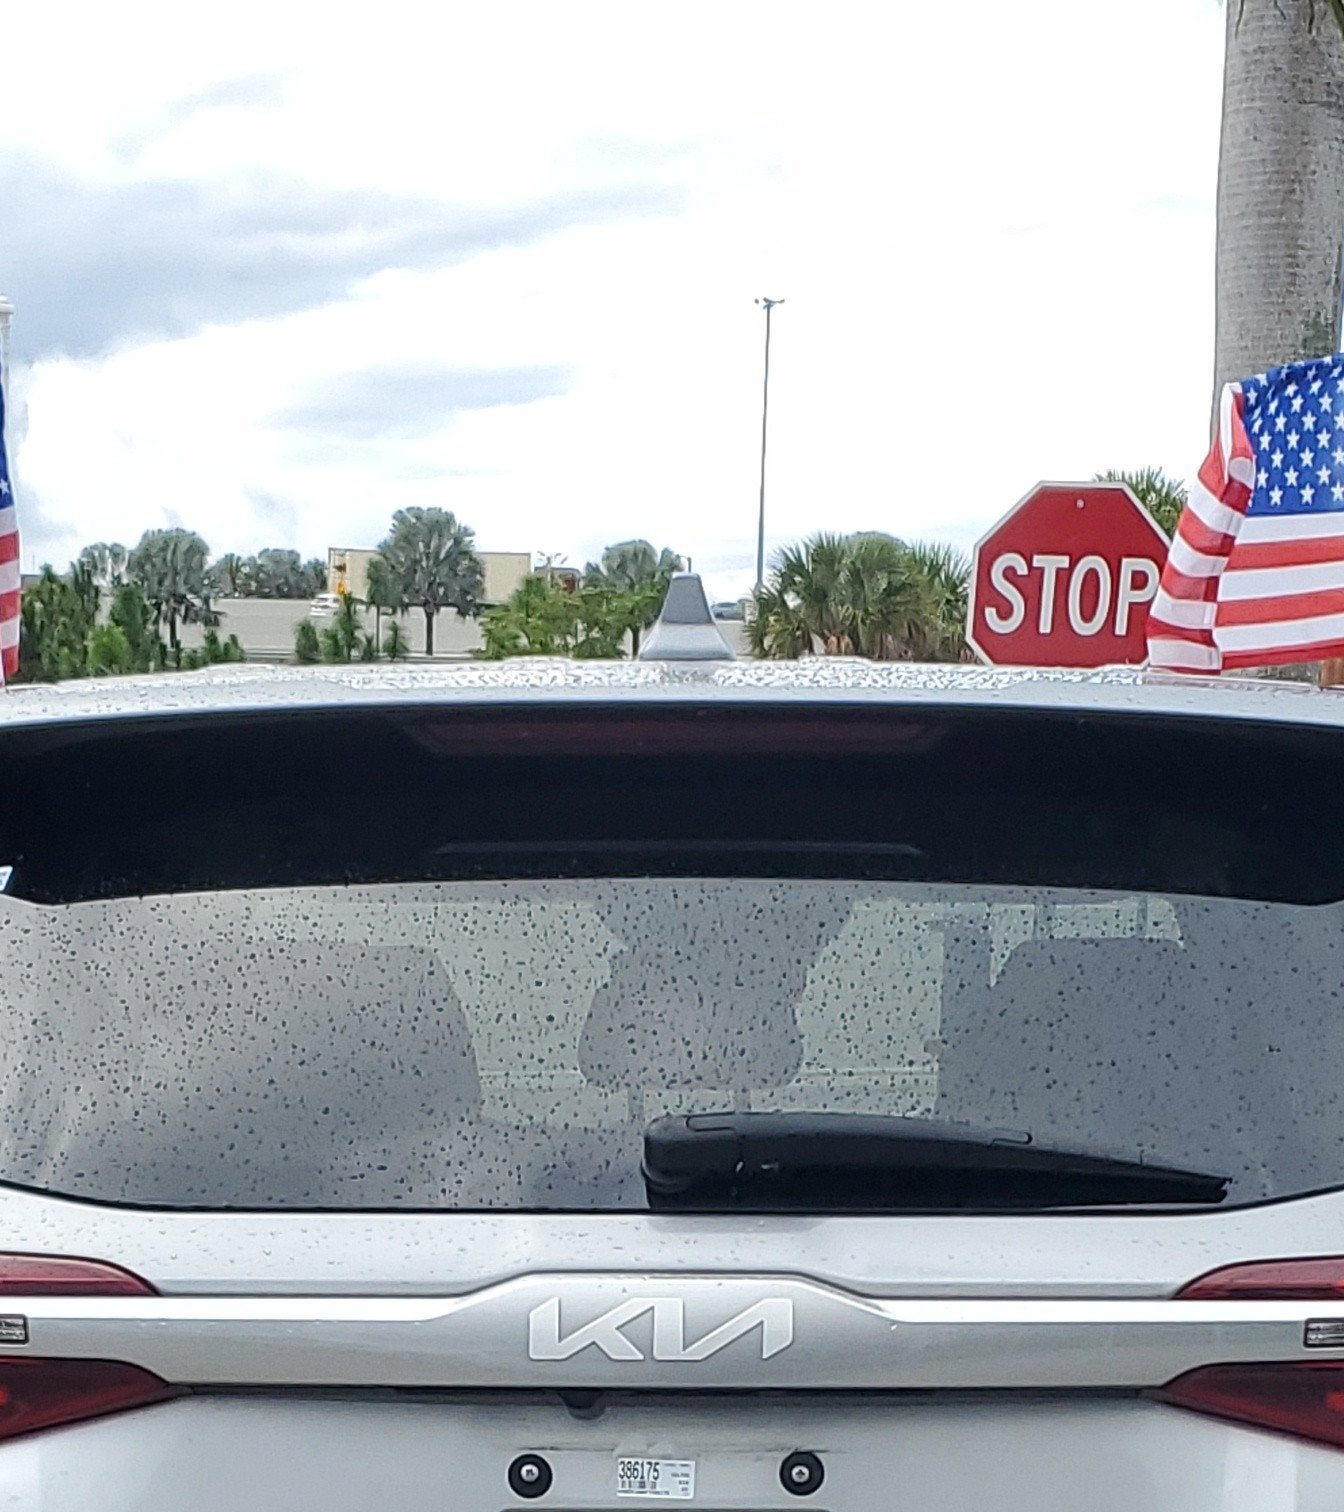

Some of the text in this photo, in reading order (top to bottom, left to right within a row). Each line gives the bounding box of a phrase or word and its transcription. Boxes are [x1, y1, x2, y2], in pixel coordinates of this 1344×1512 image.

[984, 552, 1160, 636] STOP
[528, 1296, 794, 1362] KIA
[618, 1460, 661, 1481] 386175
